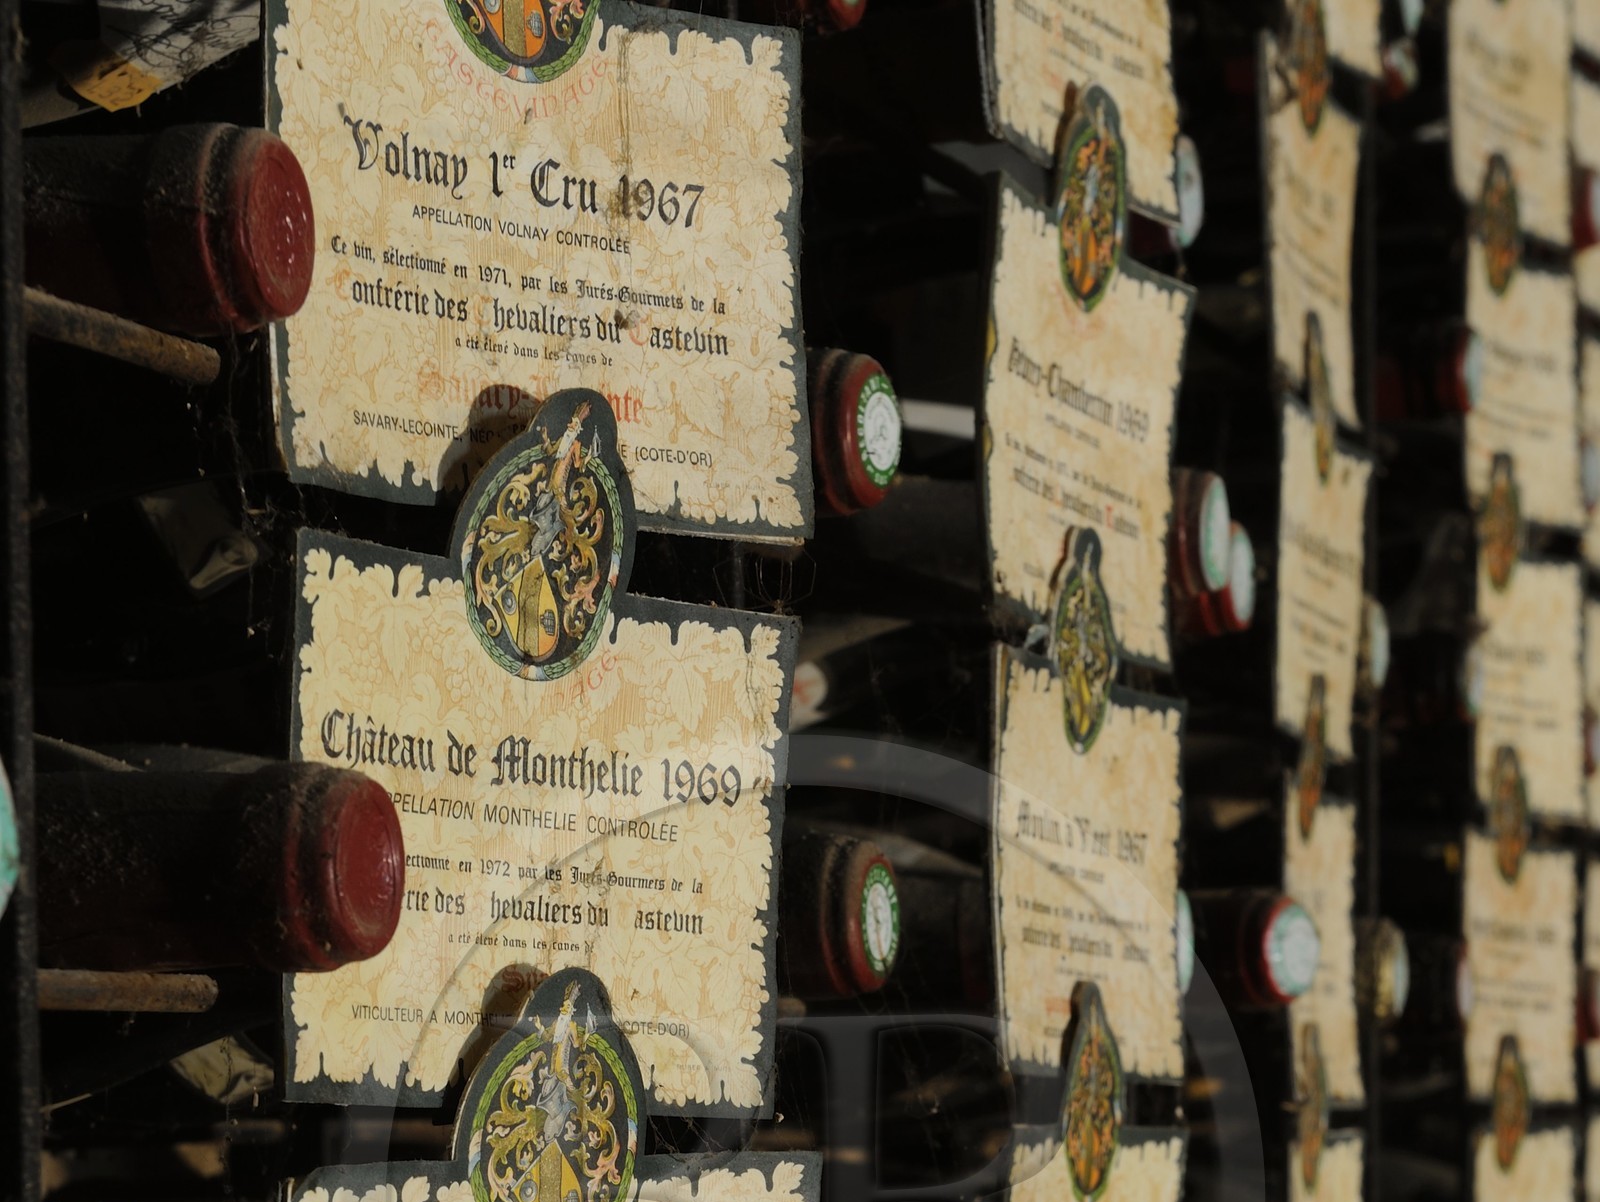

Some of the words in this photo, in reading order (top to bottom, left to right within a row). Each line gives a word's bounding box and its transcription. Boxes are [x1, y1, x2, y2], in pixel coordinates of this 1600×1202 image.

[342, 115, 468, 200] Volnay
[489, 150, 516, 198] 1er
[530, 157, 599, 215] Cru
[618, 174, 705, 229] 1967
[412, 204, 493, 233] APPELLATION
[498, 219, 549, 242] VOLNAY
[331, 235, 347, 254] Ce
[354, 240, 376, 264] vin,
[382, 246, 447, 275] sélectionné
[453, 264, 468, 279] en
[478, 265, 512, 289] 1971,
[521, 275, 541, 291] par
[549, 276, 568, 295] les
[690, 295, 705, 313] de
[713, 298, 726, 315] la
[434, 288, 469, 322] des
[595, 312, 622, 344] du
[455, 338, 461, 348] a
[466, 336, 478, 350] été
[484, 336, 509, 355] élevé
[514, 342, 539, 359] dans
[544, 345, 560, 361] les
[566, 351, 597, 365] caves
[601, 352, 613, 367] de
[634, 446, 713, 468] (COTE-D'OR)
[321, 708, 436, 770] Château
[446, 729, 478, 778] de
[491, 734, 643, 801] Monthelie
[661, 758, 742, 808] 1969
[387, 791, 474, 820] PELLATION
[483, 803, 576, 832] MONTHELIE
[405, 855, 450, 871] ectionné
[459, 860, 472, 873] en
[481, 859, 510, 877] 1972
[518, 867, 538, 880] par
[545, 865, 562, 881] les
[671, 877, 683, 892] de
[692, 878, 703, 894] la
[435, 887, 465, 915] des
[588, 901, 608, 927] du
[634, 910, 704, 936] astevin
[448, 934, 453, 943] a
[503, 936, 526, 949] dans
[533, 938, 547, 950] les
[553, 940, 580, 952] caves
[351, 1005, 423, 1023] VITICULTEUR
[430, 1012, 438, 1023] A
[621, 1020, 690, 1040] COTE-D'OR)
